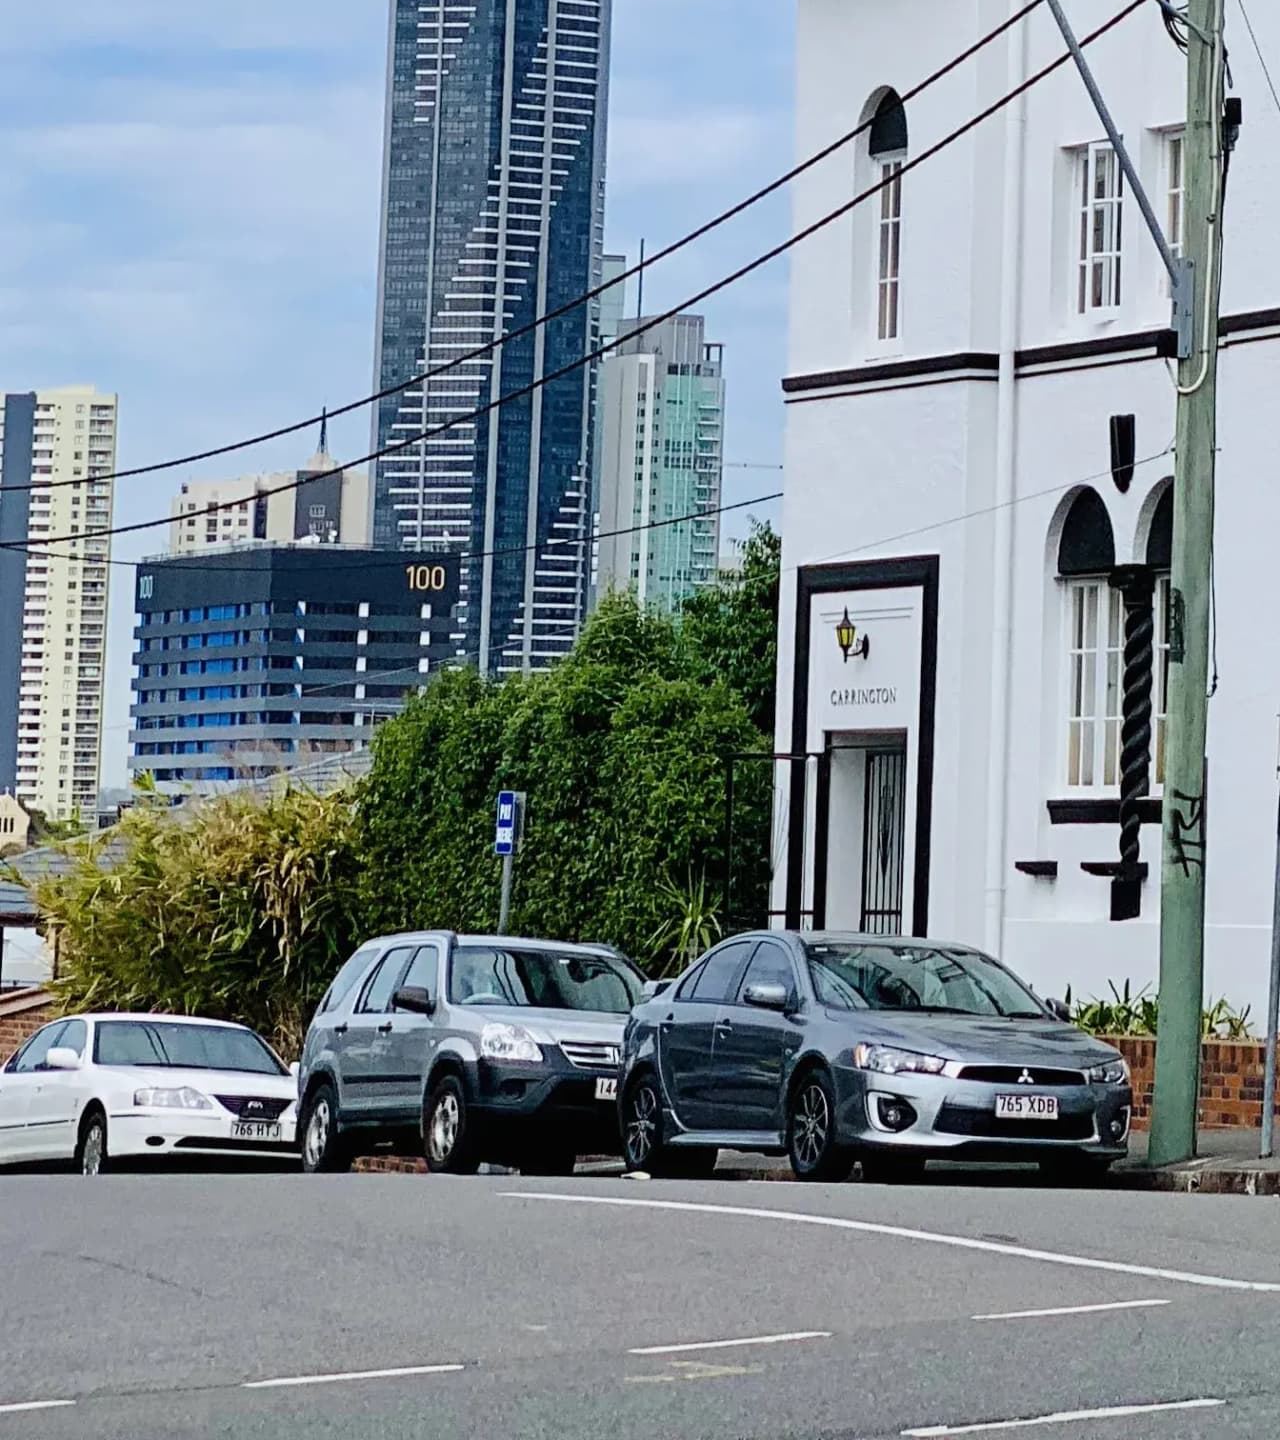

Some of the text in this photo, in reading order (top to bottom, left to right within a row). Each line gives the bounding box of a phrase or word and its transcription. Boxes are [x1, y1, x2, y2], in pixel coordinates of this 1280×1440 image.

[140, 575, 153, 599] 100
[406, 565, 446, 590] 100
[830, 687, 897, 706] CARRINGTON
[999, 1096, 1055, 1113] 765 XDB
[234, 1123, 253, 1136] 766
